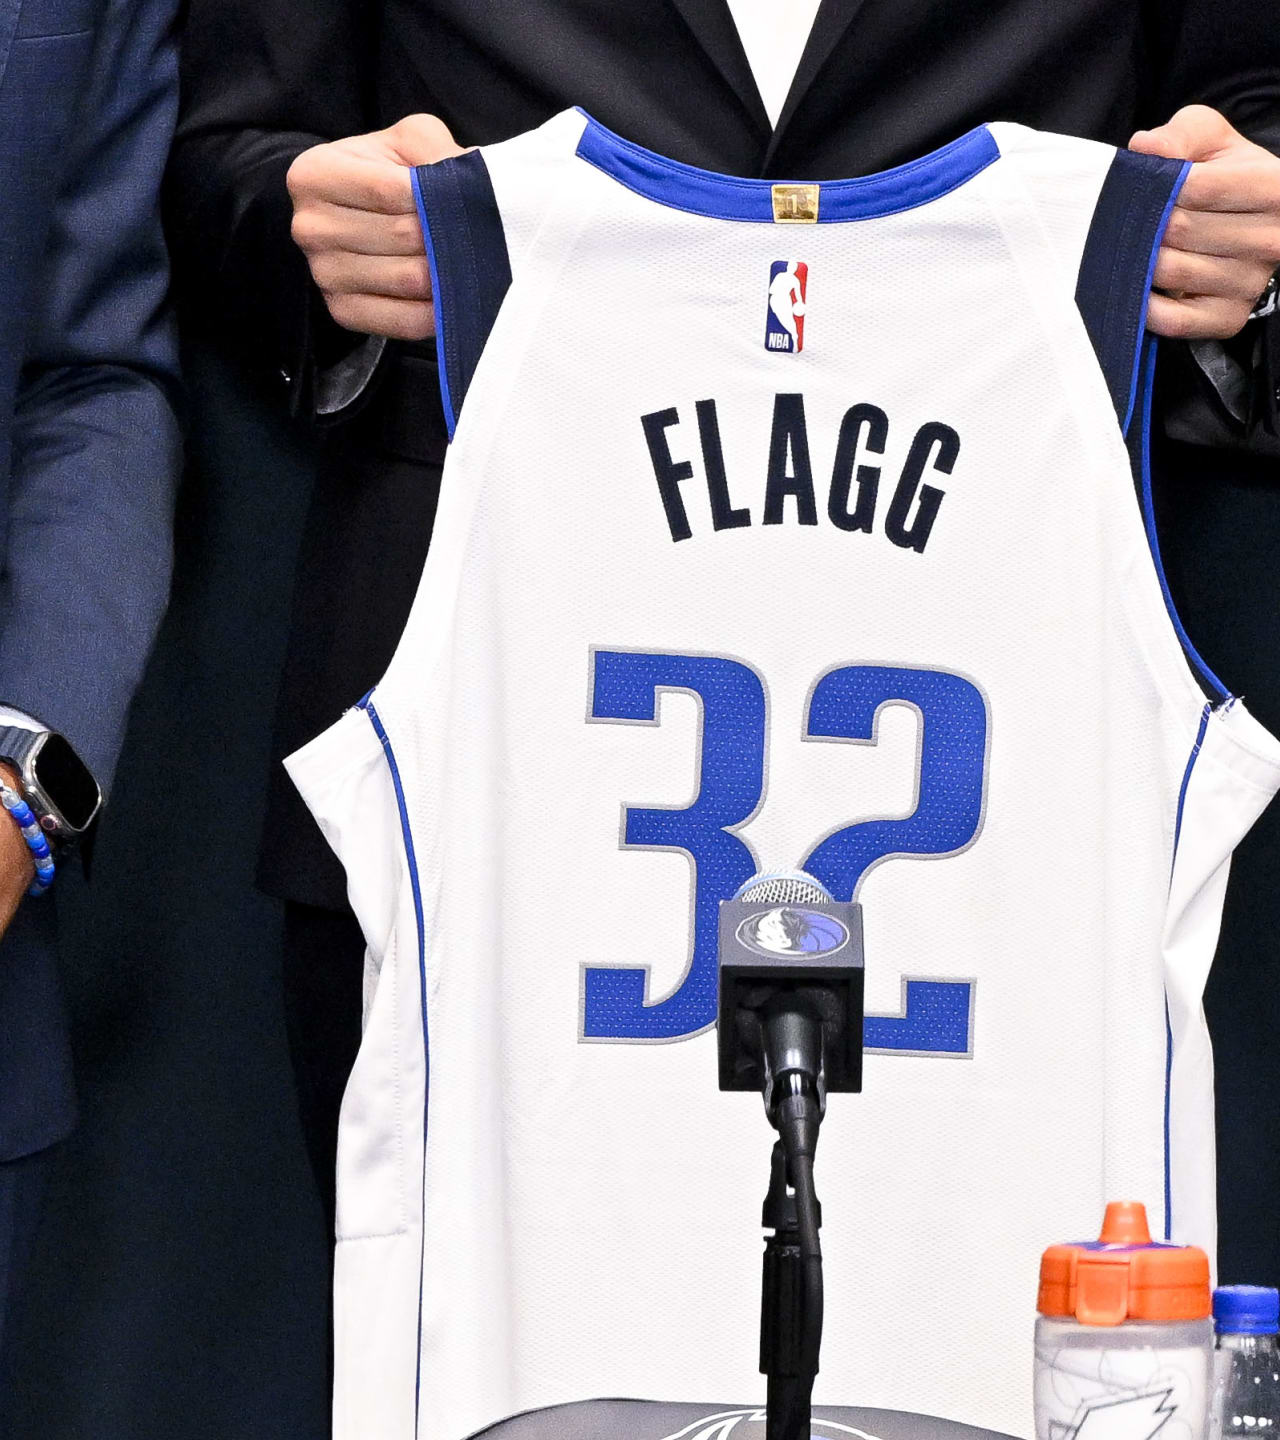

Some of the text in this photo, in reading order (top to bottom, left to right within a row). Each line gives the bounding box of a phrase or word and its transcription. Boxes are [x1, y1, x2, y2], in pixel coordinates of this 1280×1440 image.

[768, 332, 789, 350] NBA
[640, 392, 962, 554] FLAGG
[577, 643, 992, 1060] 32
